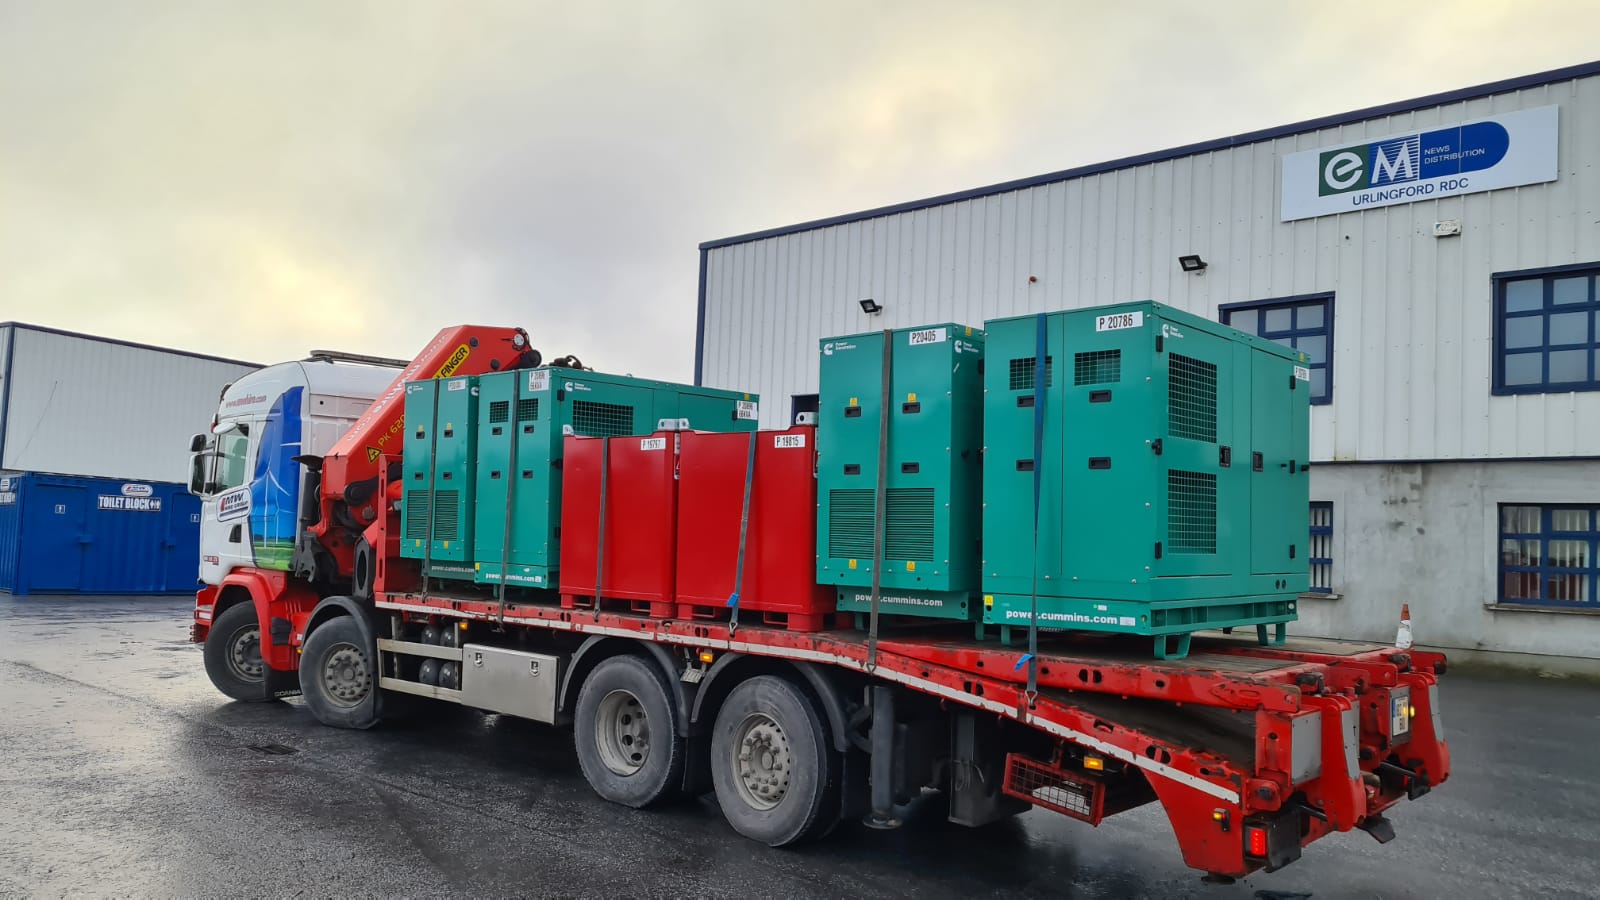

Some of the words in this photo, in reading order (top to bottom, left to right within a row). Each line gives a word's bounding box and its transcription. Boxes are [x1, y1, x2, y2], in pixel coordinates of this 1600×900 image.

[1424, 145, 1450, 156] NEWS
[1424, 148, 1485, 165] DISTRIBUTION
[1352, 184, 1435, 206] URLINGFORD
[1439, 177, 1470, 192] RDC
[1099, 317, 1105, 330] P
[1108, 314, 1133, 329] 20786
[911, 330, 936, 343] P20405
[437, 346, 469, 379] FINGER
[378, 432, 391, 447] PK
[99, 496, 124, 509] TOILET
[125, 497, 150, 510] BLOCK
[855, 593, 943, 607] pow.cummins.com
[1005, 609, 1118, 626] powe.cummins.com
